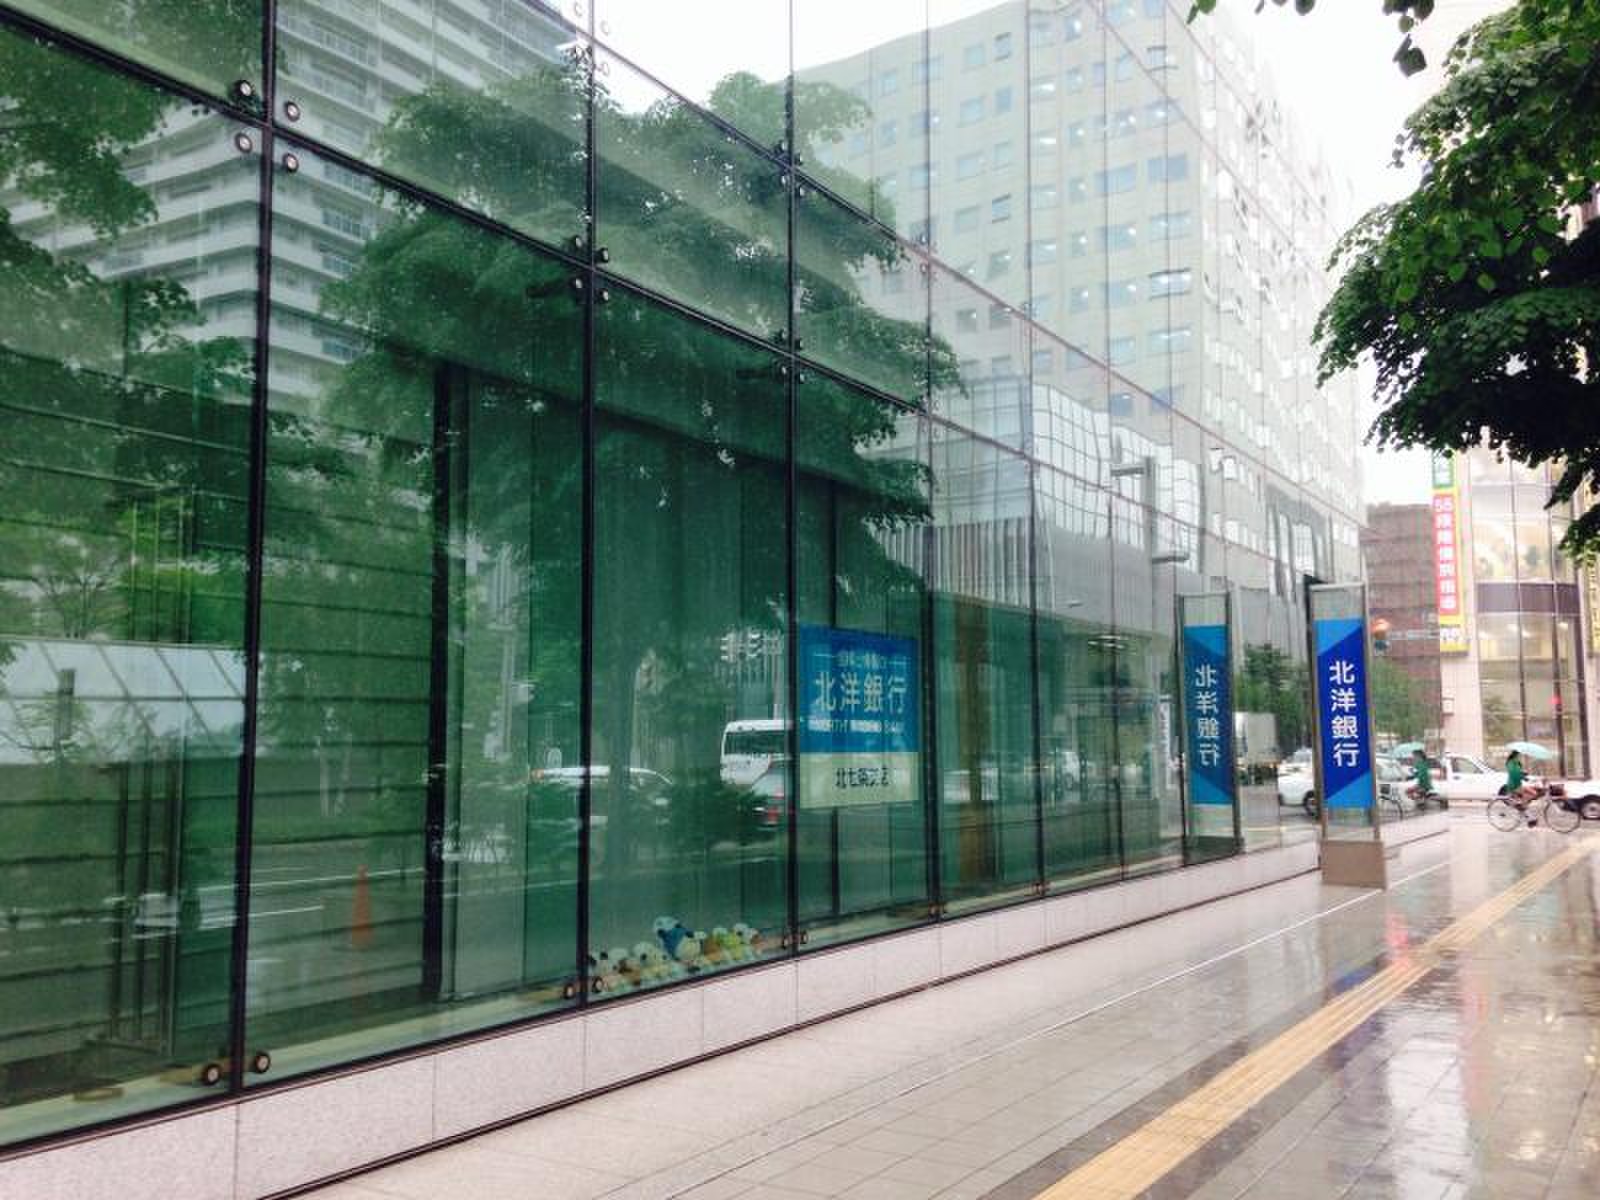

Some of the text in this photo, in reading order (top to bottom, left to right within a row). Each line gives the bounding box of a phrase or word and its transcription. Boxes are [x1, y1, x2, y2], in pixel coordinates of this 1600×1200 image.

[815, 671, 907, 715] 北洋銀行
[1328, 660, 1360, 768] 北洋銀行
